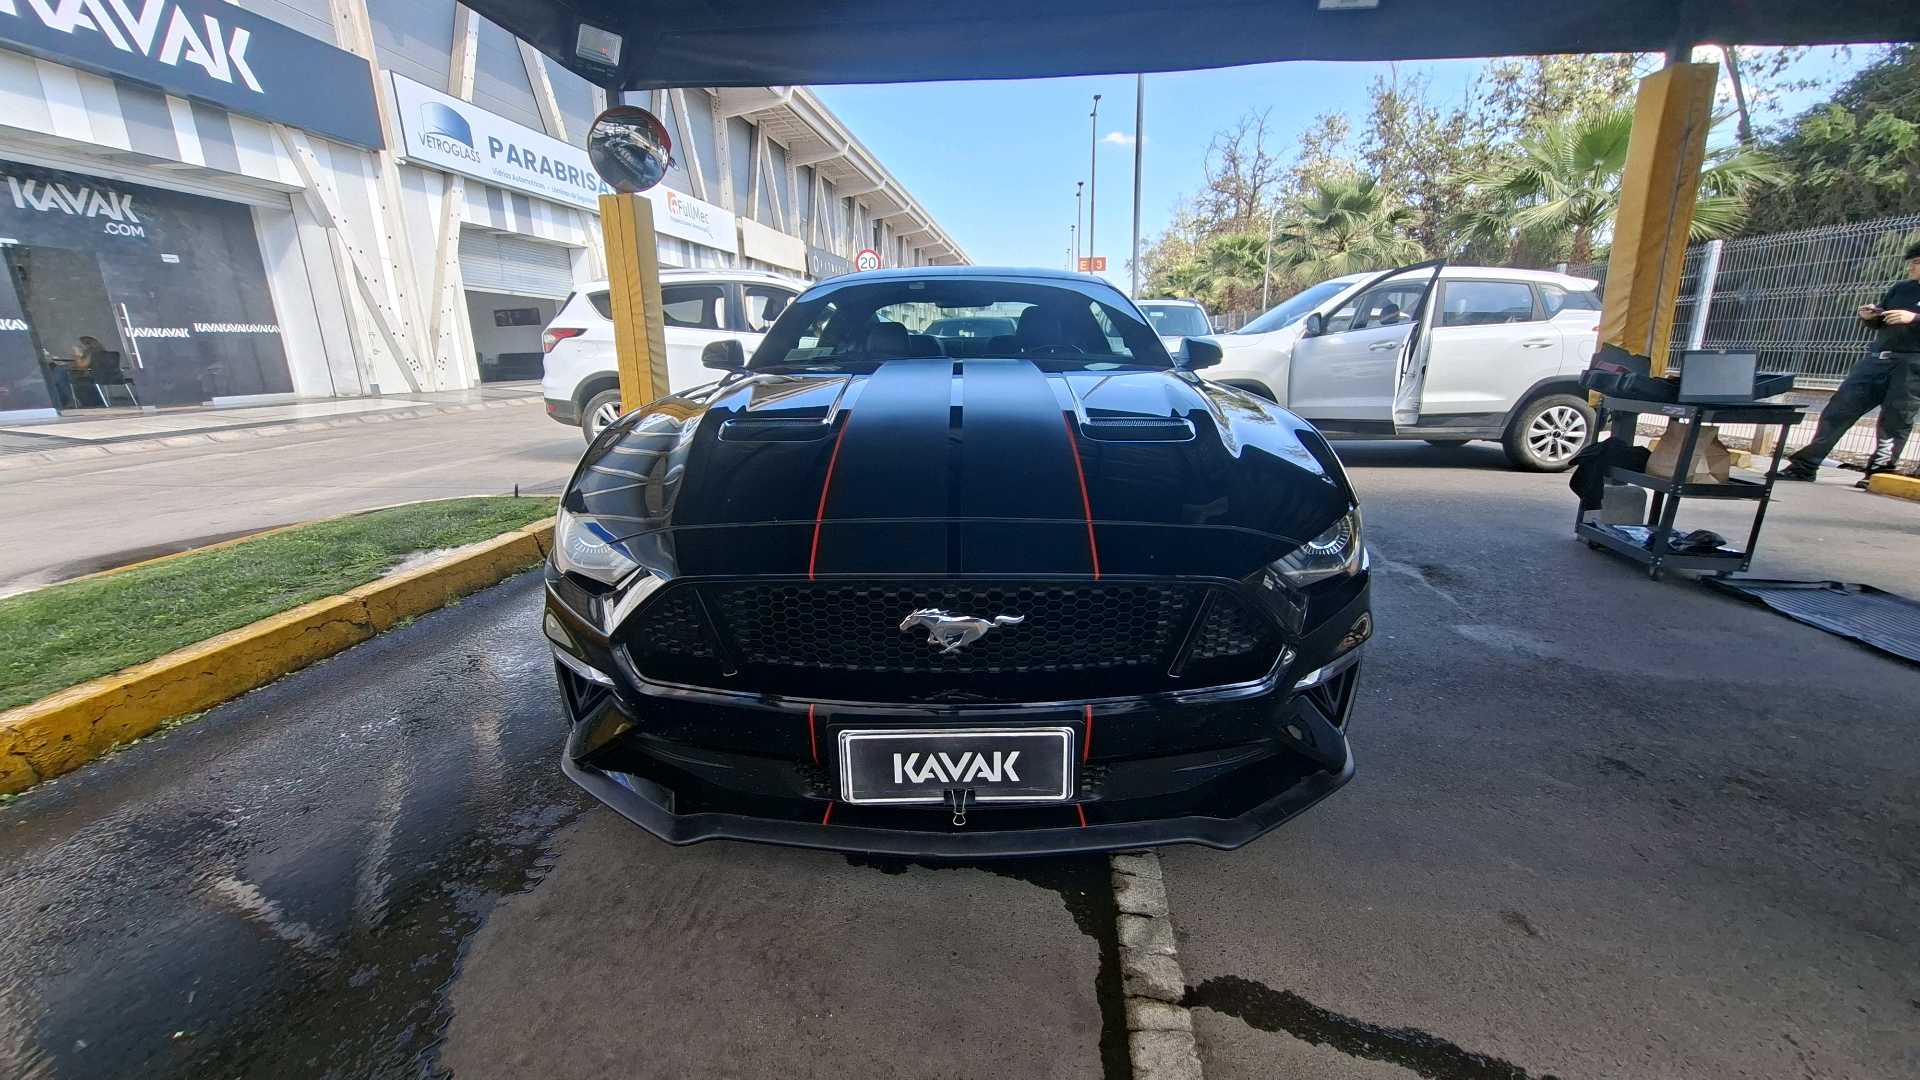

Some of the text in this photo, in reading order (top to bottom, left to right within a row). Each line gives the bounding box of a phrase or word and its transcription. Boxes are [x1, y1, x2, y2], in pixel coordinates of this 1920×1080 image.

[418, 130, 481, 164] VETROGLASS
[488, 136, 609, 194] PARABRISA
[7, 176, 140, 223] KAVAK
[104, 222, 145, 238] .COM
[860, 256, 876, 269] 20
[893, 751, 1020, 784] KAVAK
